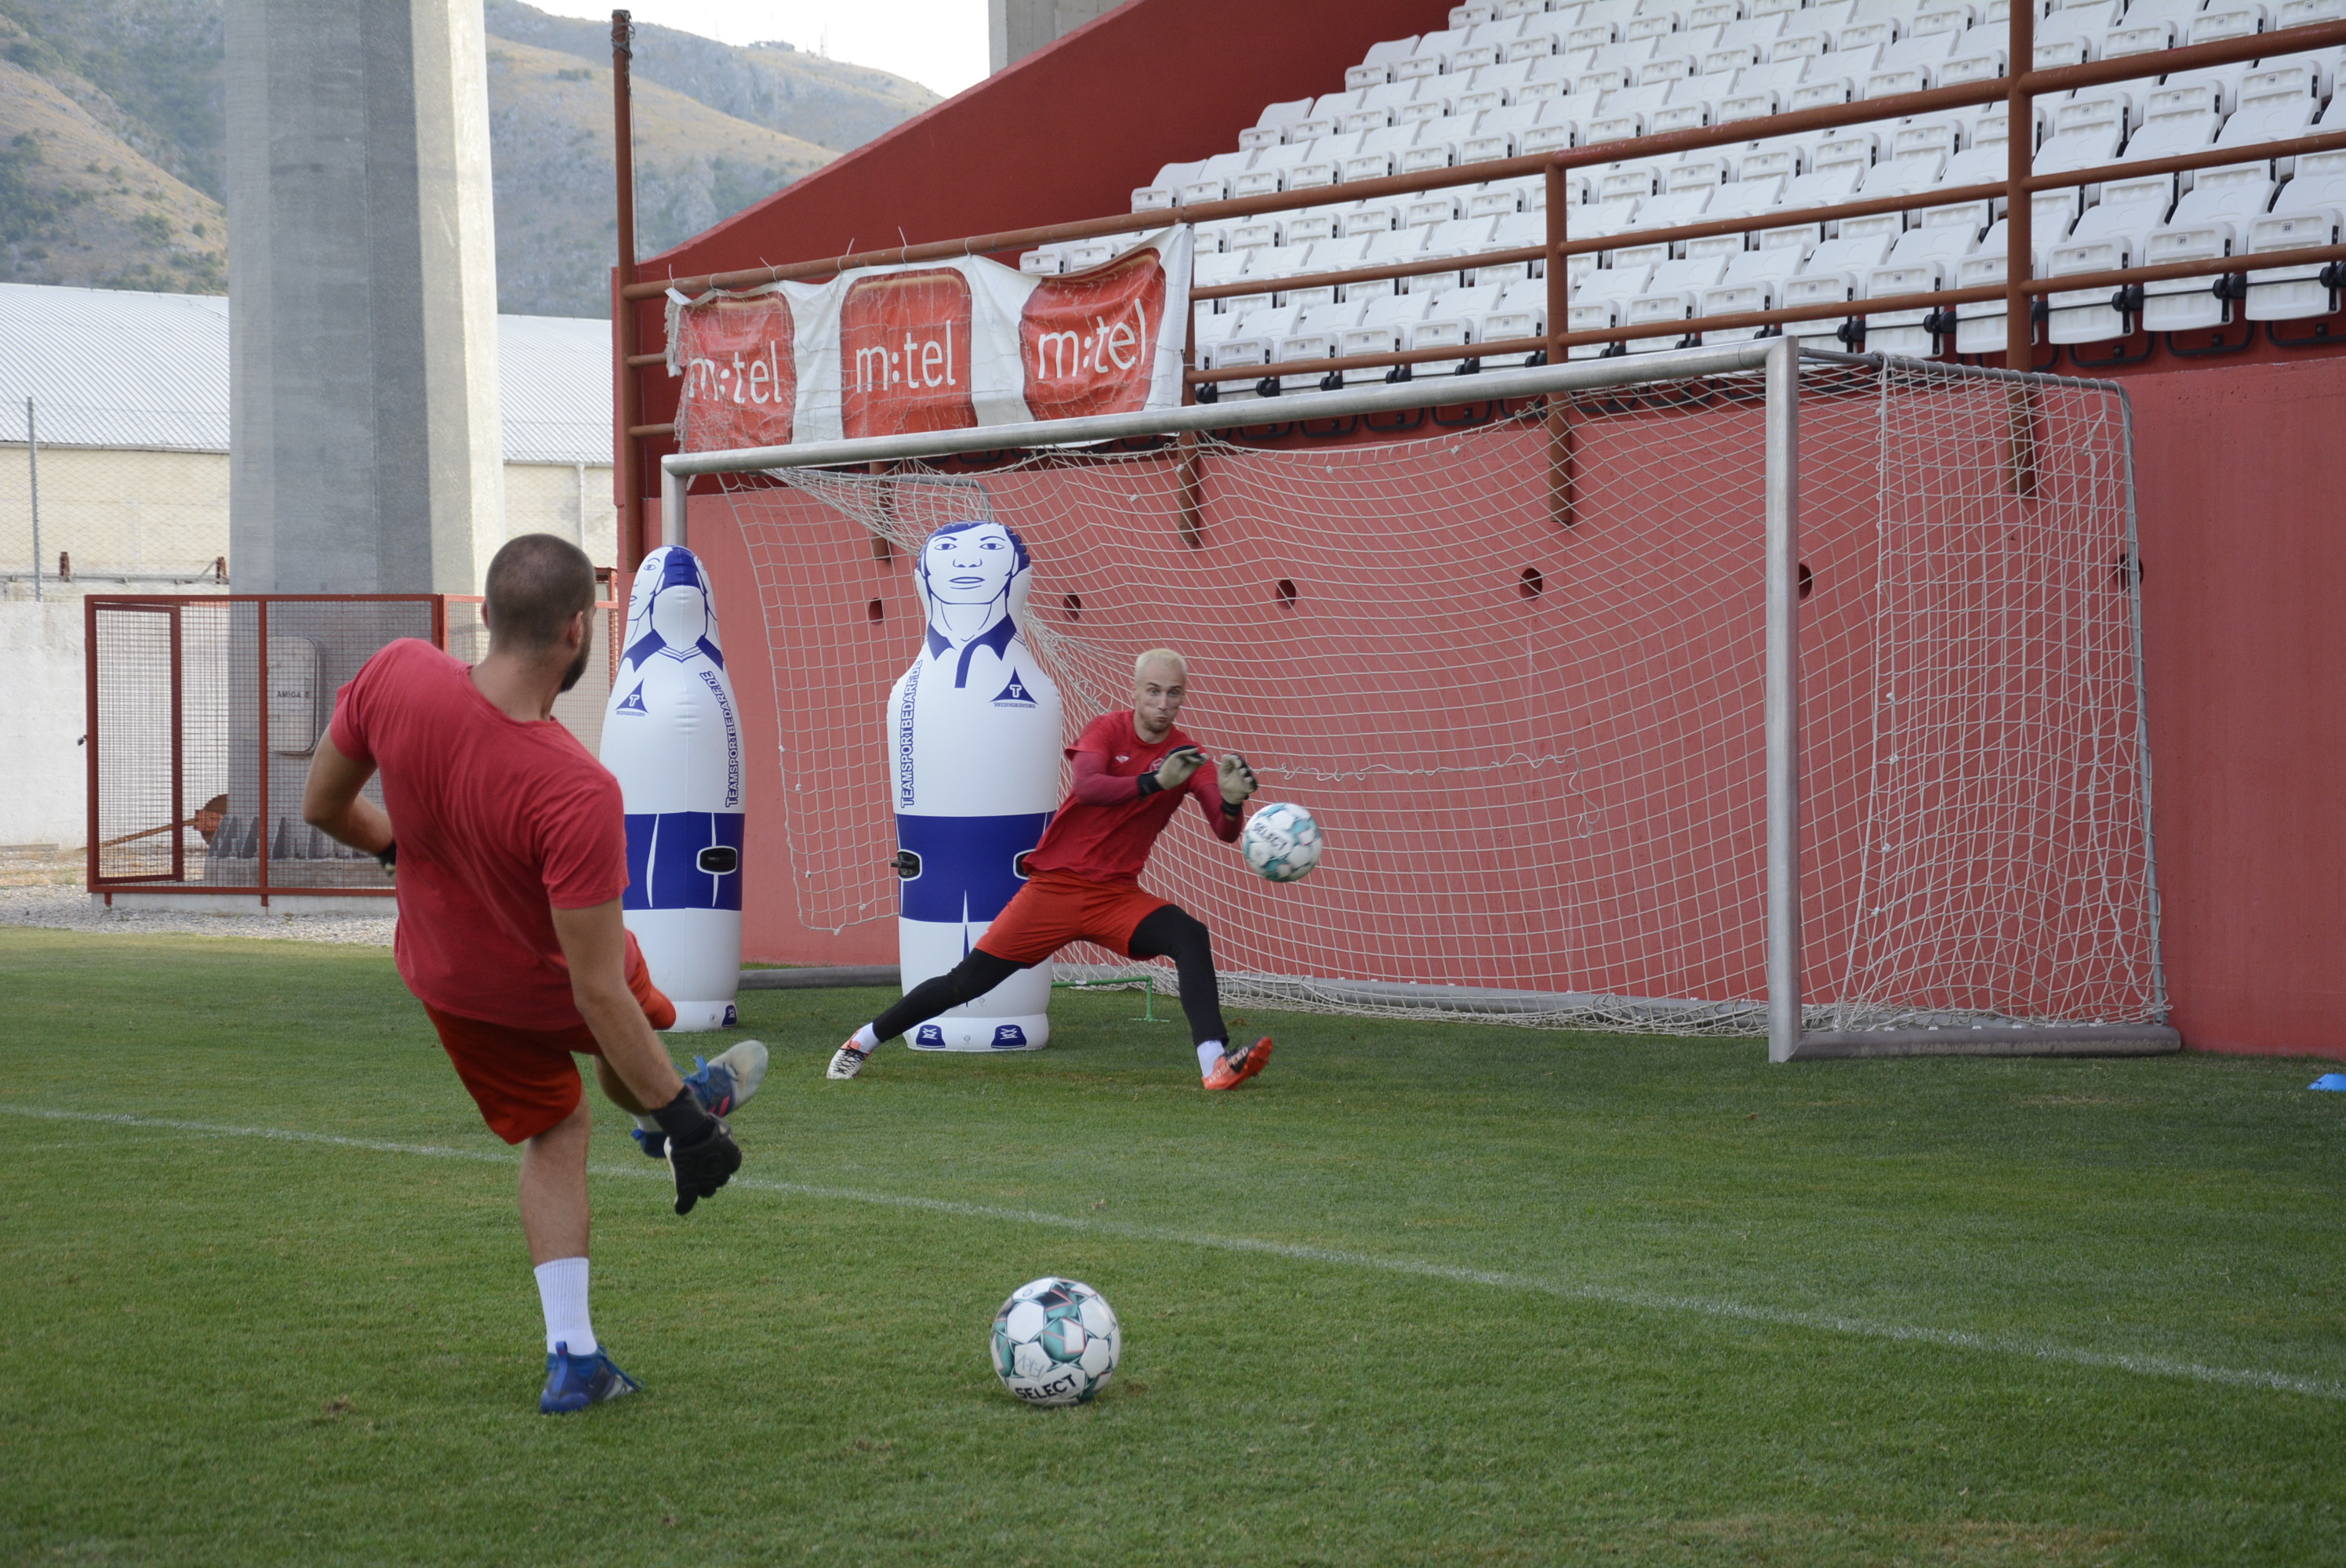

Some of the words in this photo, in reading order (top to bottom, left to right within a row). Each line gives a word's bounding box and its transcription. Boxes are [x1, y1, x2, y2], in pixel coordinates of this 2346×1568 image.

[688, 340, 783, 404] m:tel
[855, 320, 956, 393] m:tel
[1038, 299, 1146, 379] m:tel
[629, 694, 641, 707] T
[1008, 684, 1022, 699] T
[699, 671, 738, 808] TEAMSPORTBEDARF.DE
[900, 659, 923, 808] TEAMSPORTBEDARF.DE
[1015, 1374, 1077, 1399] SELECT
